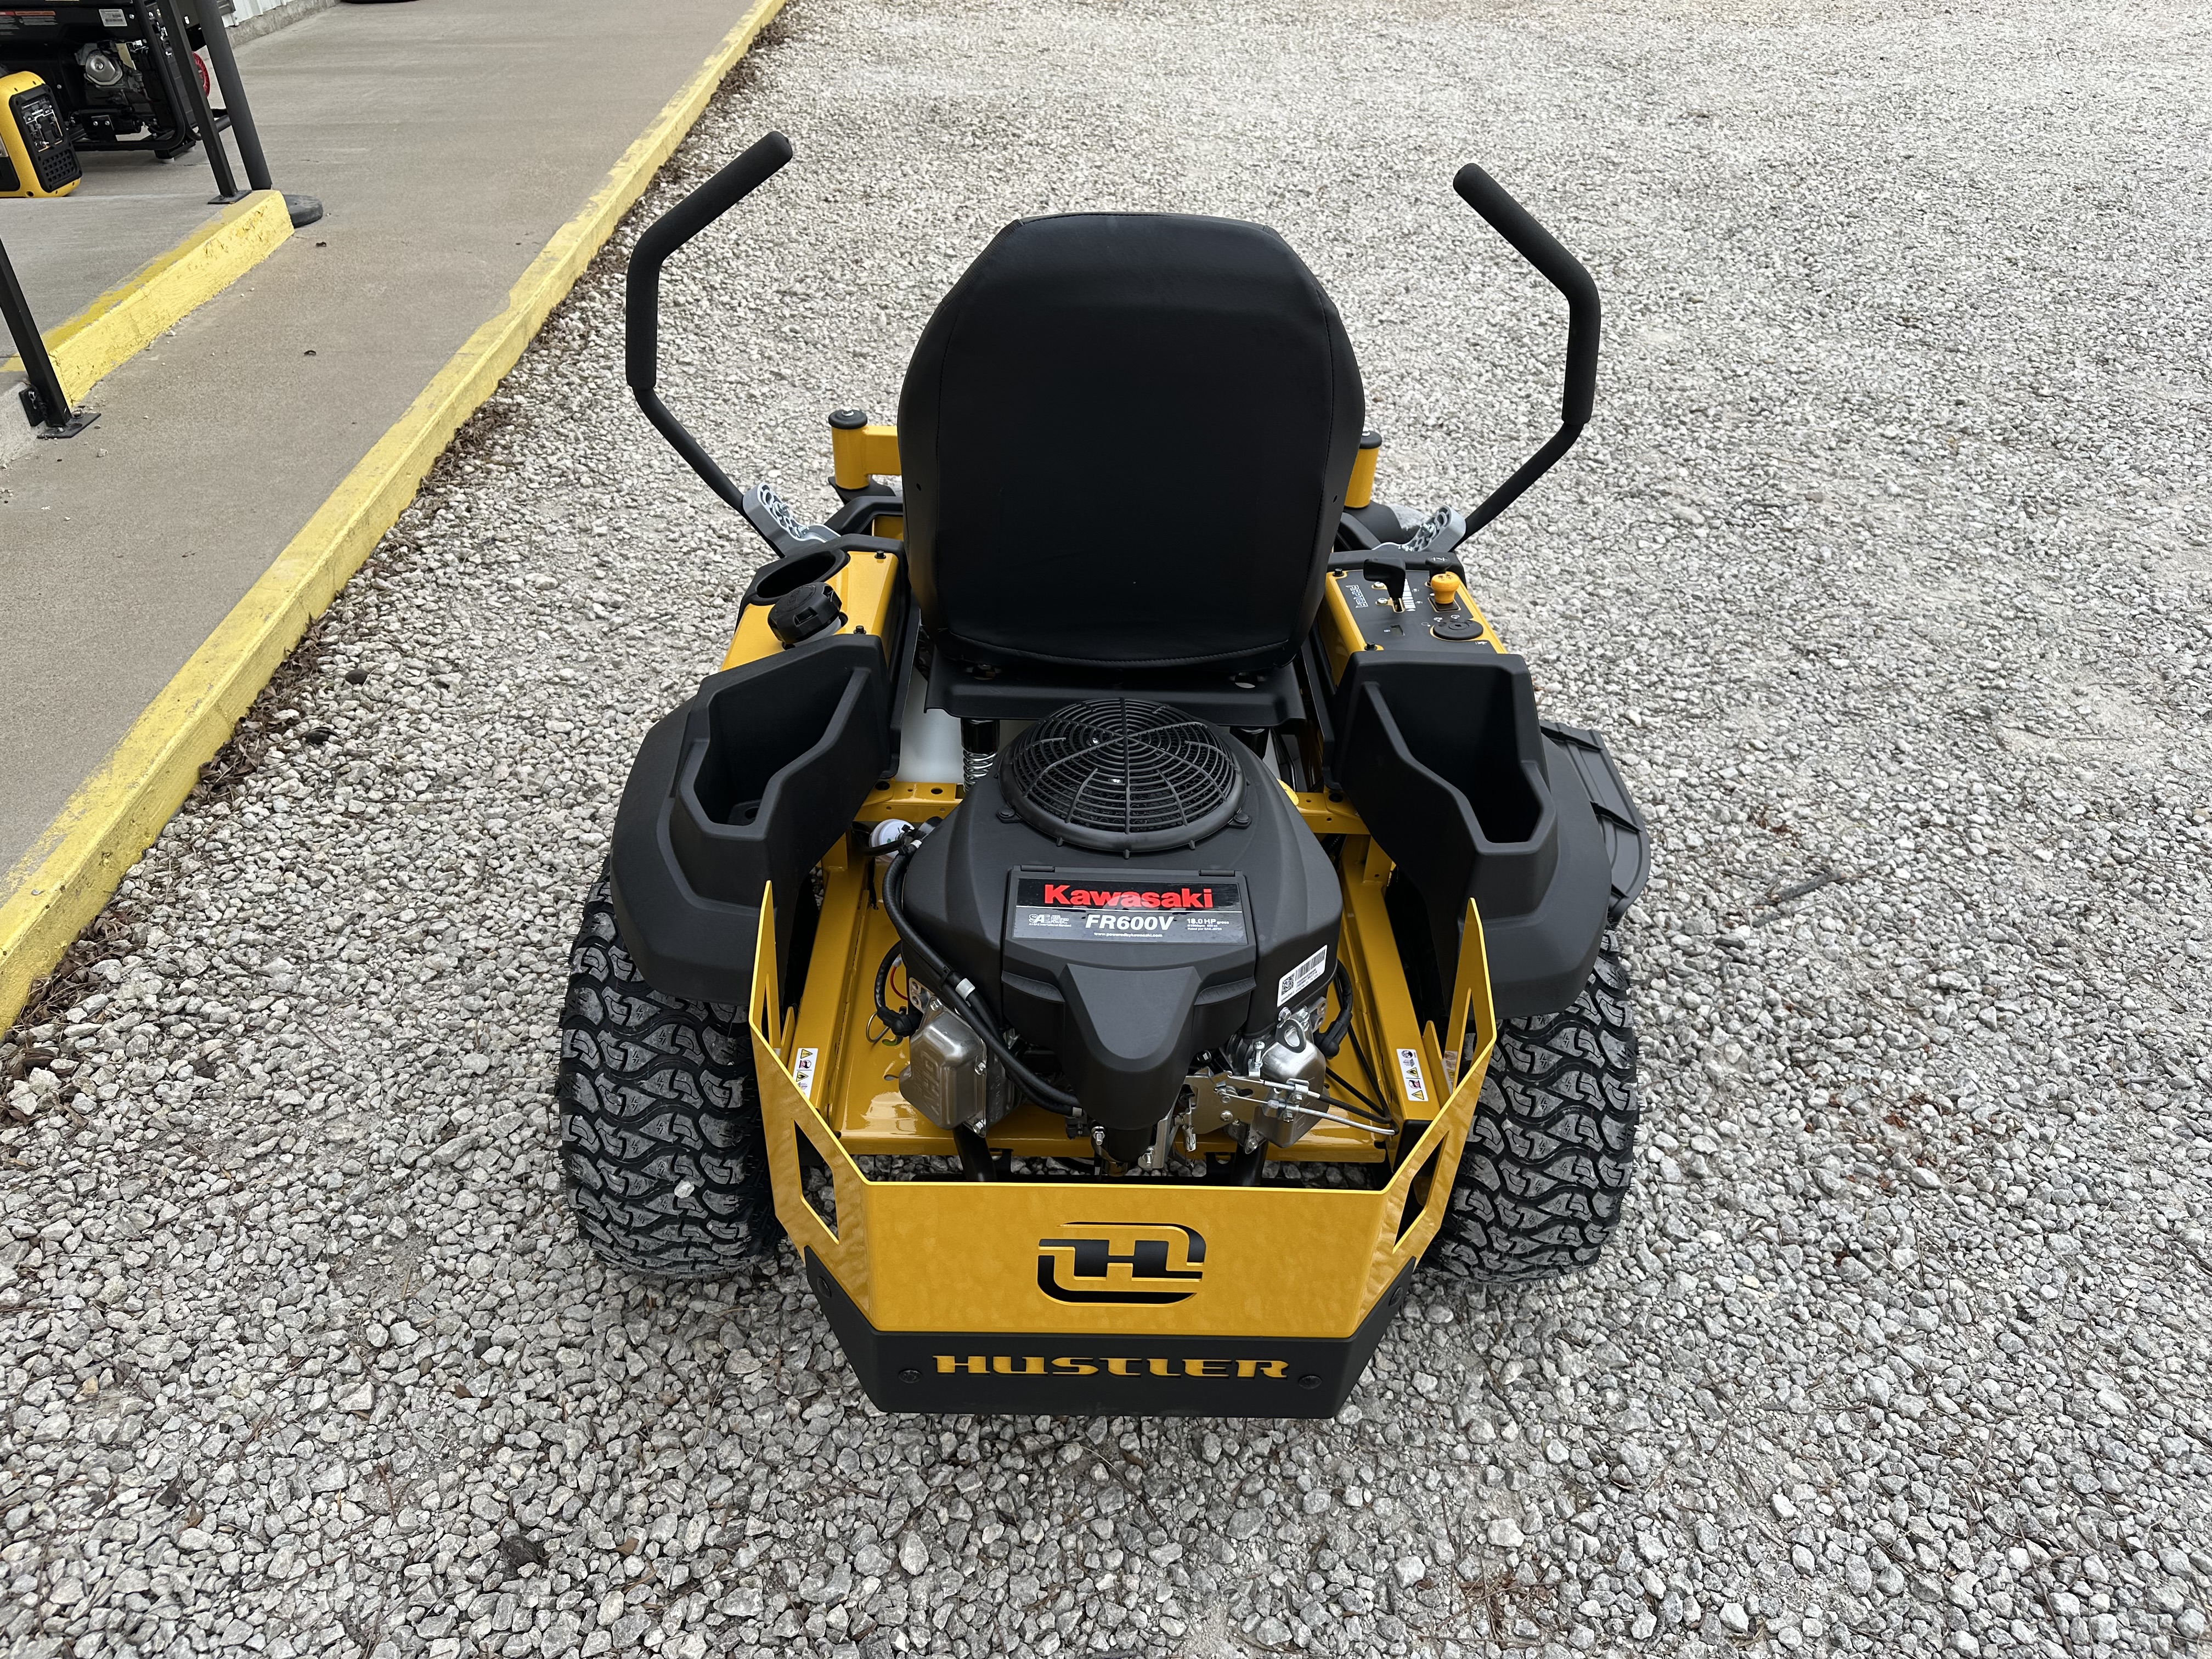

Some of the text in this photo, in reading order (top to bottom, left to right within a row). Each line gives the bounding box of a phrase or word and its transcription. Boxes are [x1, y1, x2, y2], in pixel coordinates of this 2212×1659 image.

[1045, 884, 1214, 908] Kawasaki
[1029, 913, 1051, 923] SAE
[1085, 914, 1175, 930] FR600V
[932, 1355, 1289, 1379] HUSTLER
